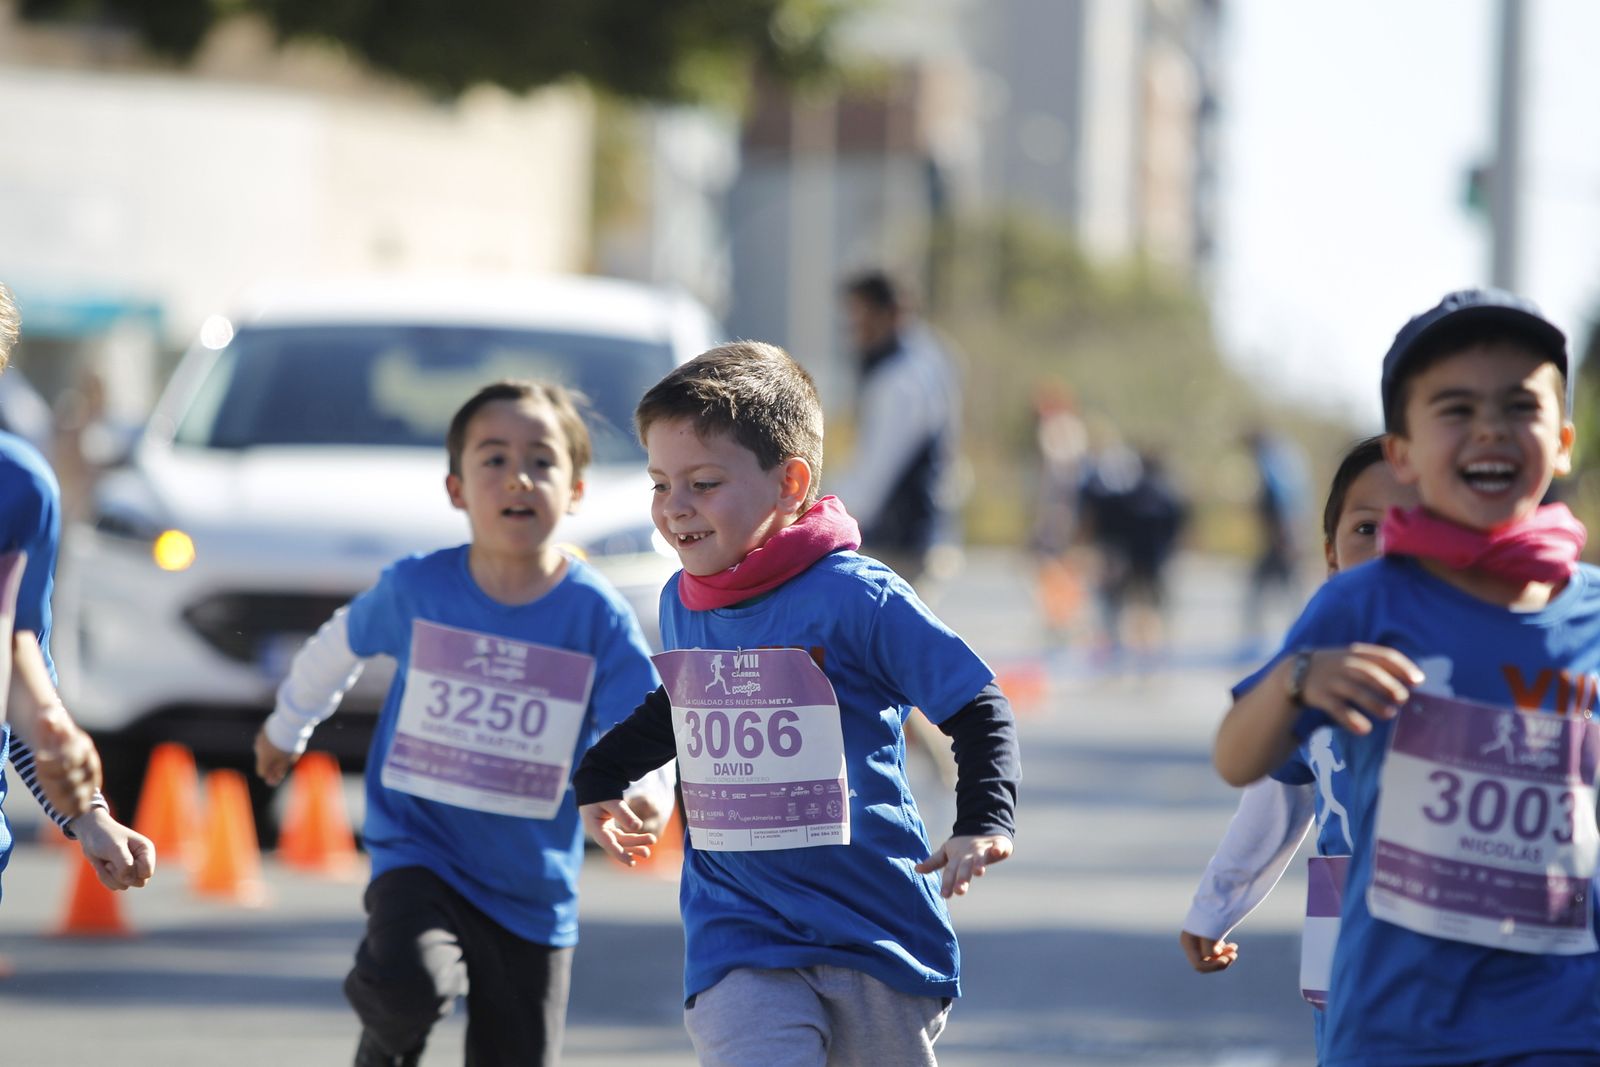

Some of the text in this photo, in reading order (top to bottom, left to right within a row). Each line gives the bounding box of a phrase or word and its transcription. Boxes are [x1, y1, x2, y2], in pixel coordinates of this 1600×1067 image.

[733, 654, 759, 669] VIII
[426, 680, 547, 738] 3250
[691, 698, 723, 706] IGUALDAD
[725, 698, 734, 706] ES
[735, 697, 768, 705] NUESTRA
[769, 697, 793, 705] META
[685, 710, 803, 759] 3066
[713, 762, 754, 776] DAVID
[1423, 770, 1575, 844] 3003
[1459, 836, 1543, 863] NICOLAS
